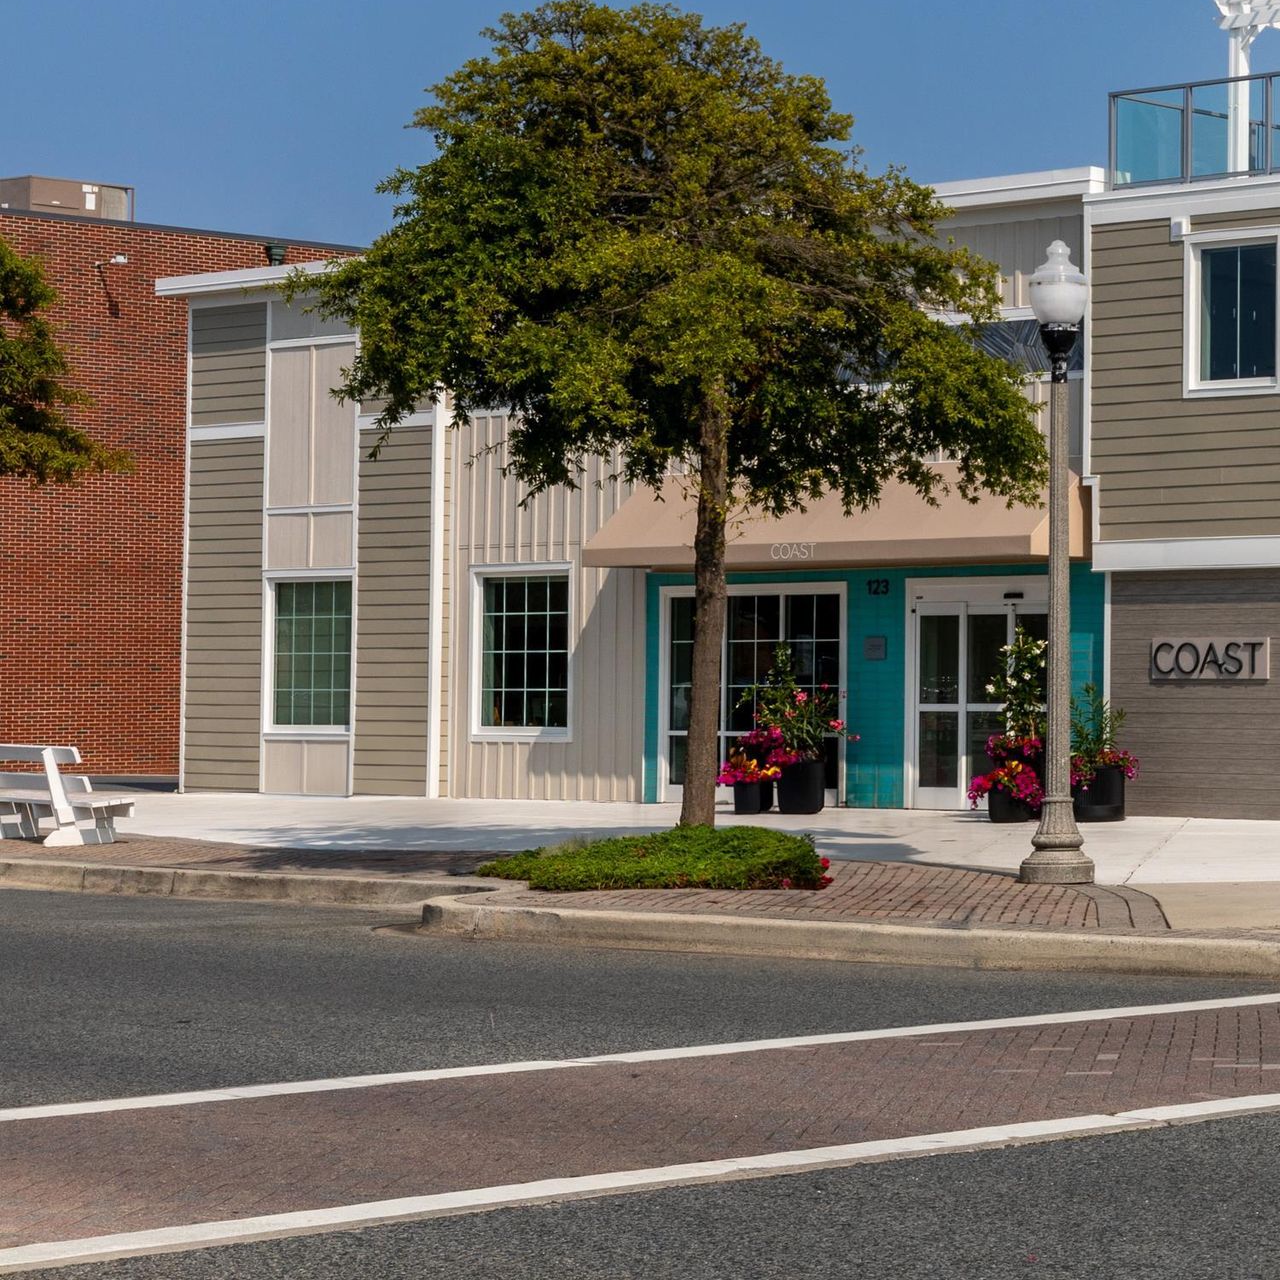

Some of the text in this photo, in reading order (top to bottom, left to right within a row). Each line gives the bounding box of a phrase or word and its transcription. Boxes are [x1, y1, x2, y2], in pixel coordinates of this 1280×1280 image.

[770, 542, 816, 559] COAST
[866, 579, 890, 595] 123
[1153, 642, 1264, 674] COAST
